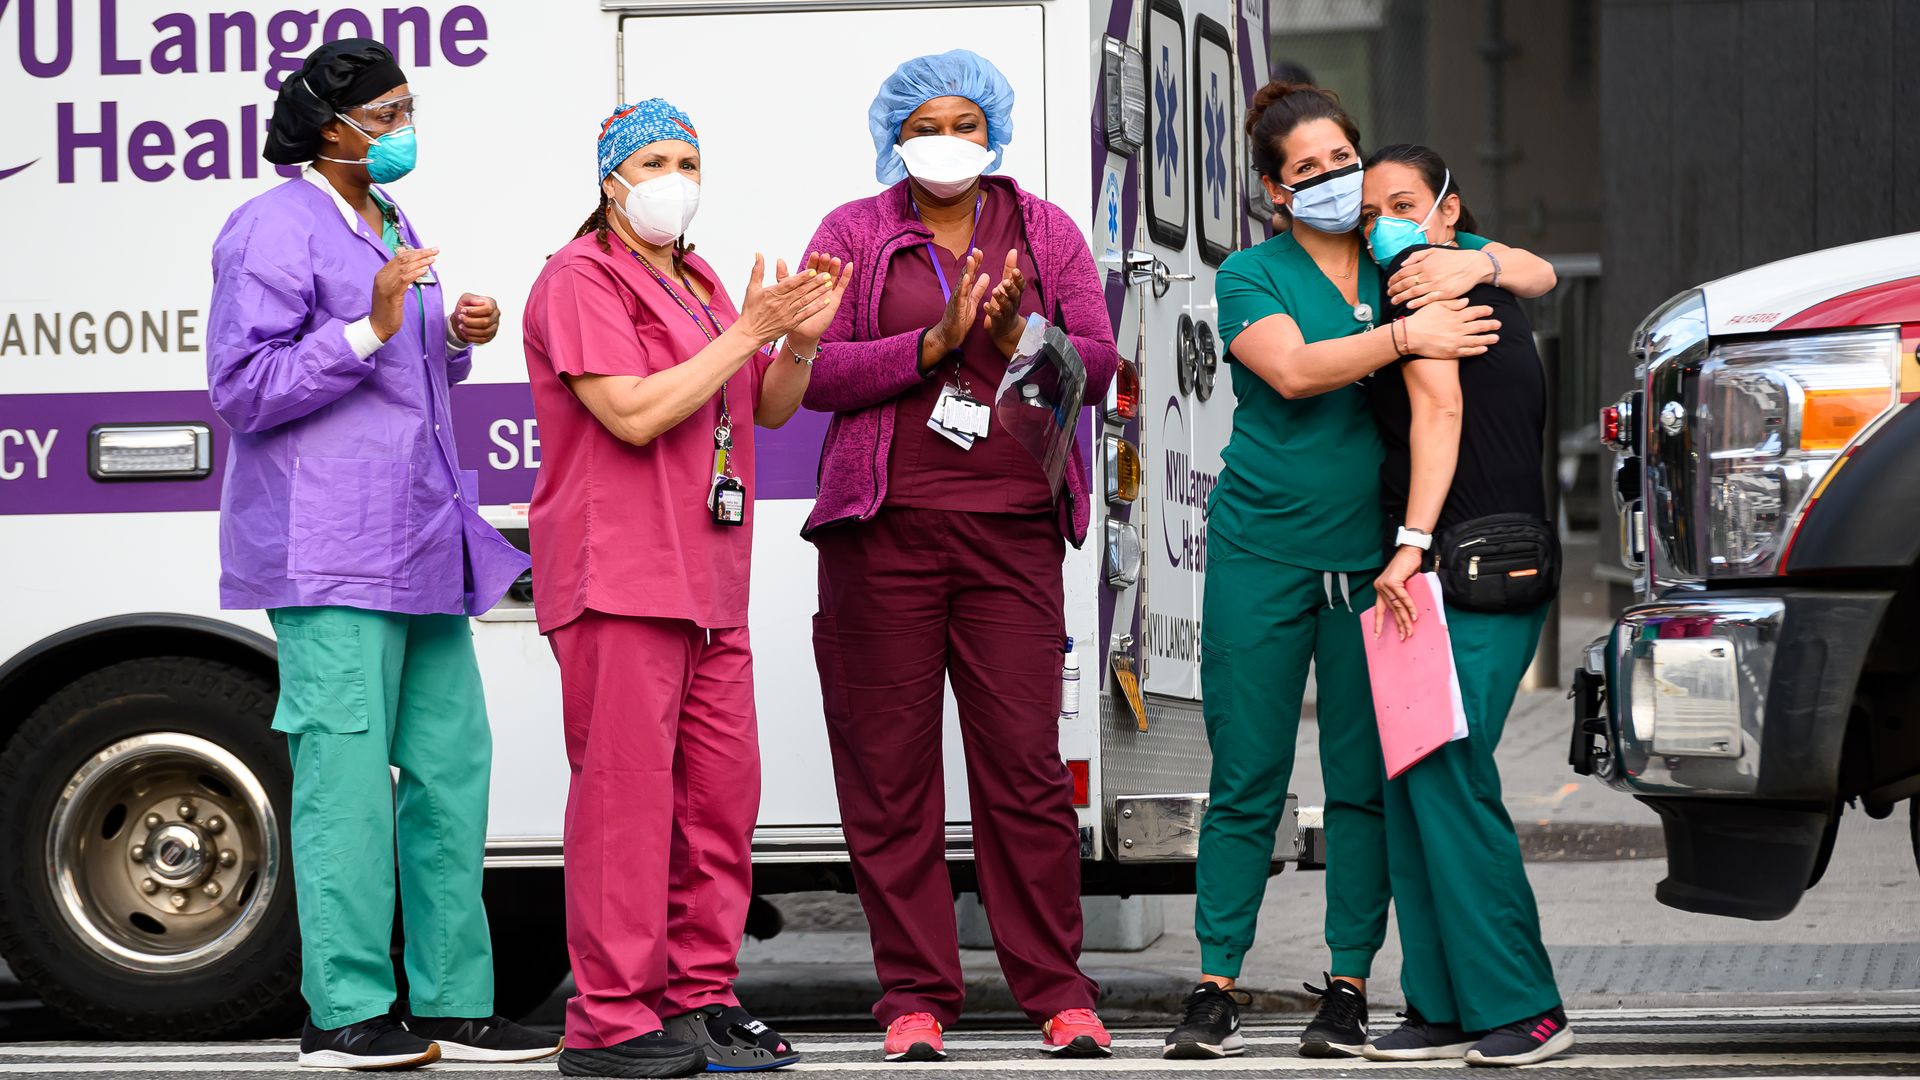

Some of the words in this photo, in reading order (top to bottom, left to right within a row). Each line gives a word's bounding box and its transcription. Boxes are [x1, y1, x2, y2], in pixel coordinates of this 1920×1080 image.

[0, 0, 73, 78] U
[56, 101, 303, 184] Heal
[0, 310, 200, 356] ANGONE
[1148, 612, 1163, 657] NYU
